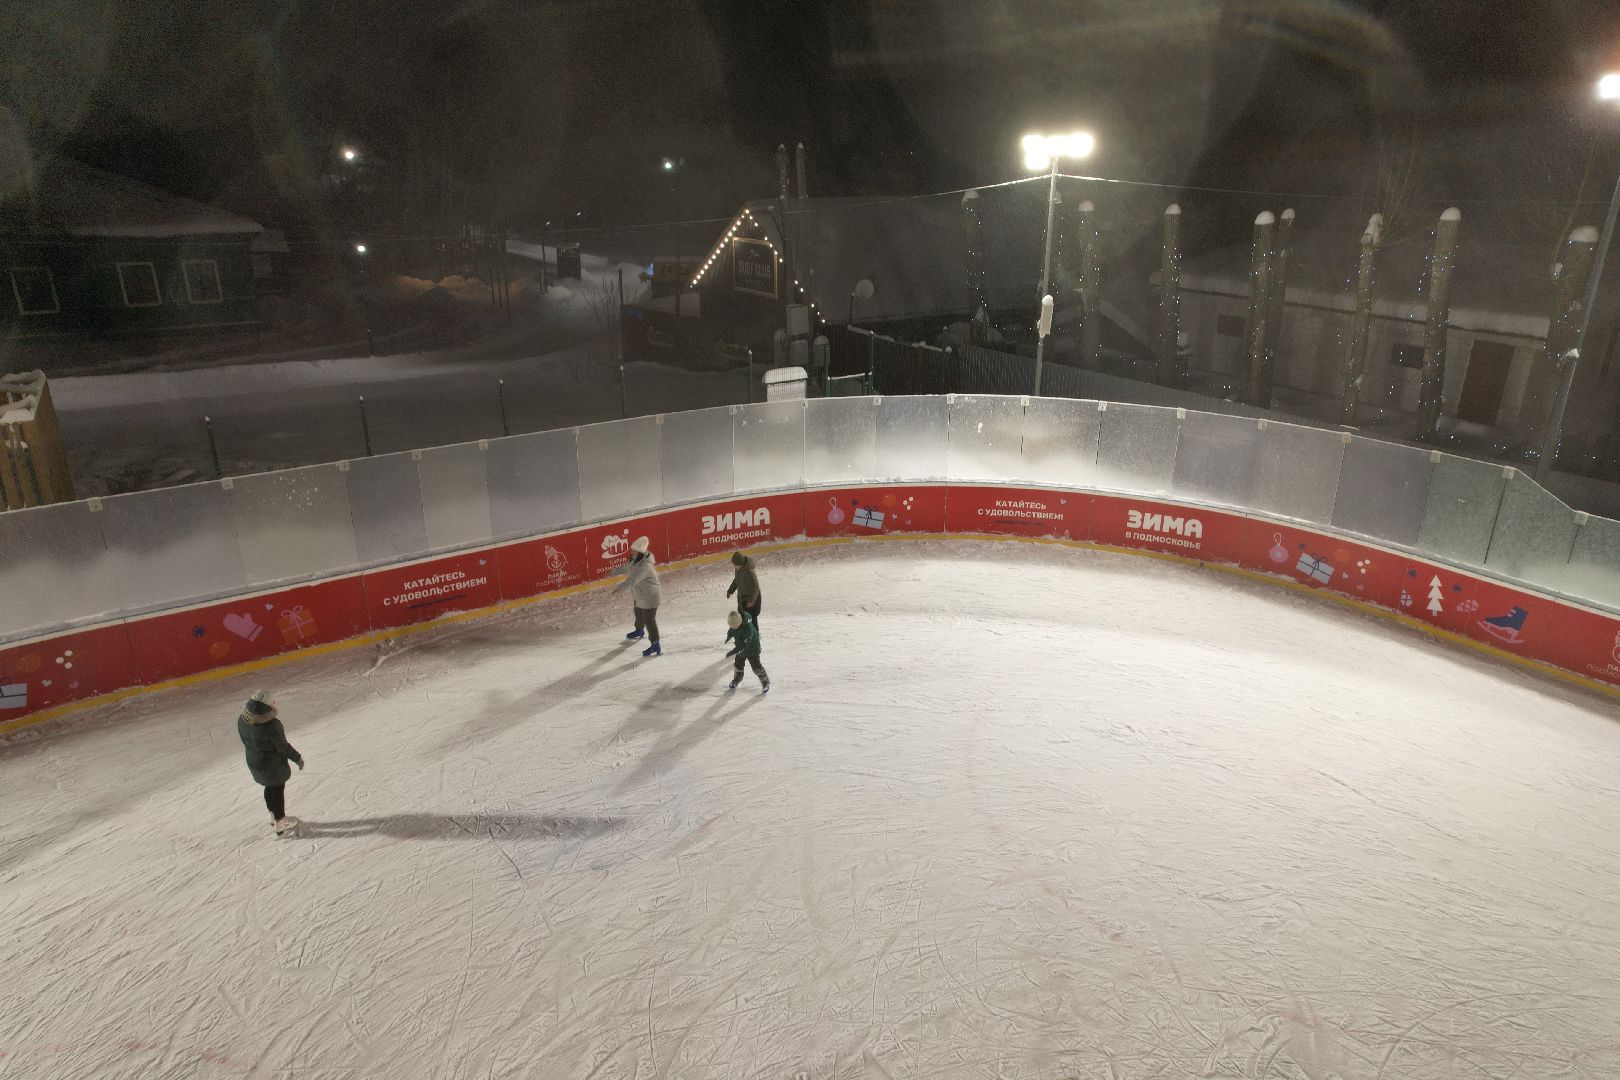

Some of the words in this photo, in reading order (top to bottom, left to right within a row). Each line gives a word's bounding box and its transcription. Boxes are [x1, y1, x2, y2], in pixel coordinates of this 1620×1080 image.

[985, 508, 1064, 520] УДОВОЛЬСТВИЕМ!
[996, 500, 1046, 510] КАТАЙТЕСЬ
[701, 507, 771, 535] ЗИМА
[1126, 509, 1203, 539] ЗИМА
[702, 538, 708, 546] В
[709, 528, 771, 545] ПОДМОСКОВЬЕ
[1125, 531, 1132, 539] В
[1133, 532, 1202, 550] ПОДМОСКОВЬЕ
[403, 570, 466, 591] КАТАЙТЕСЬ
[383, 597, 391, 606] С
[392, 576, 488, 604] УДОВОЛЬСТВИЕМ!
